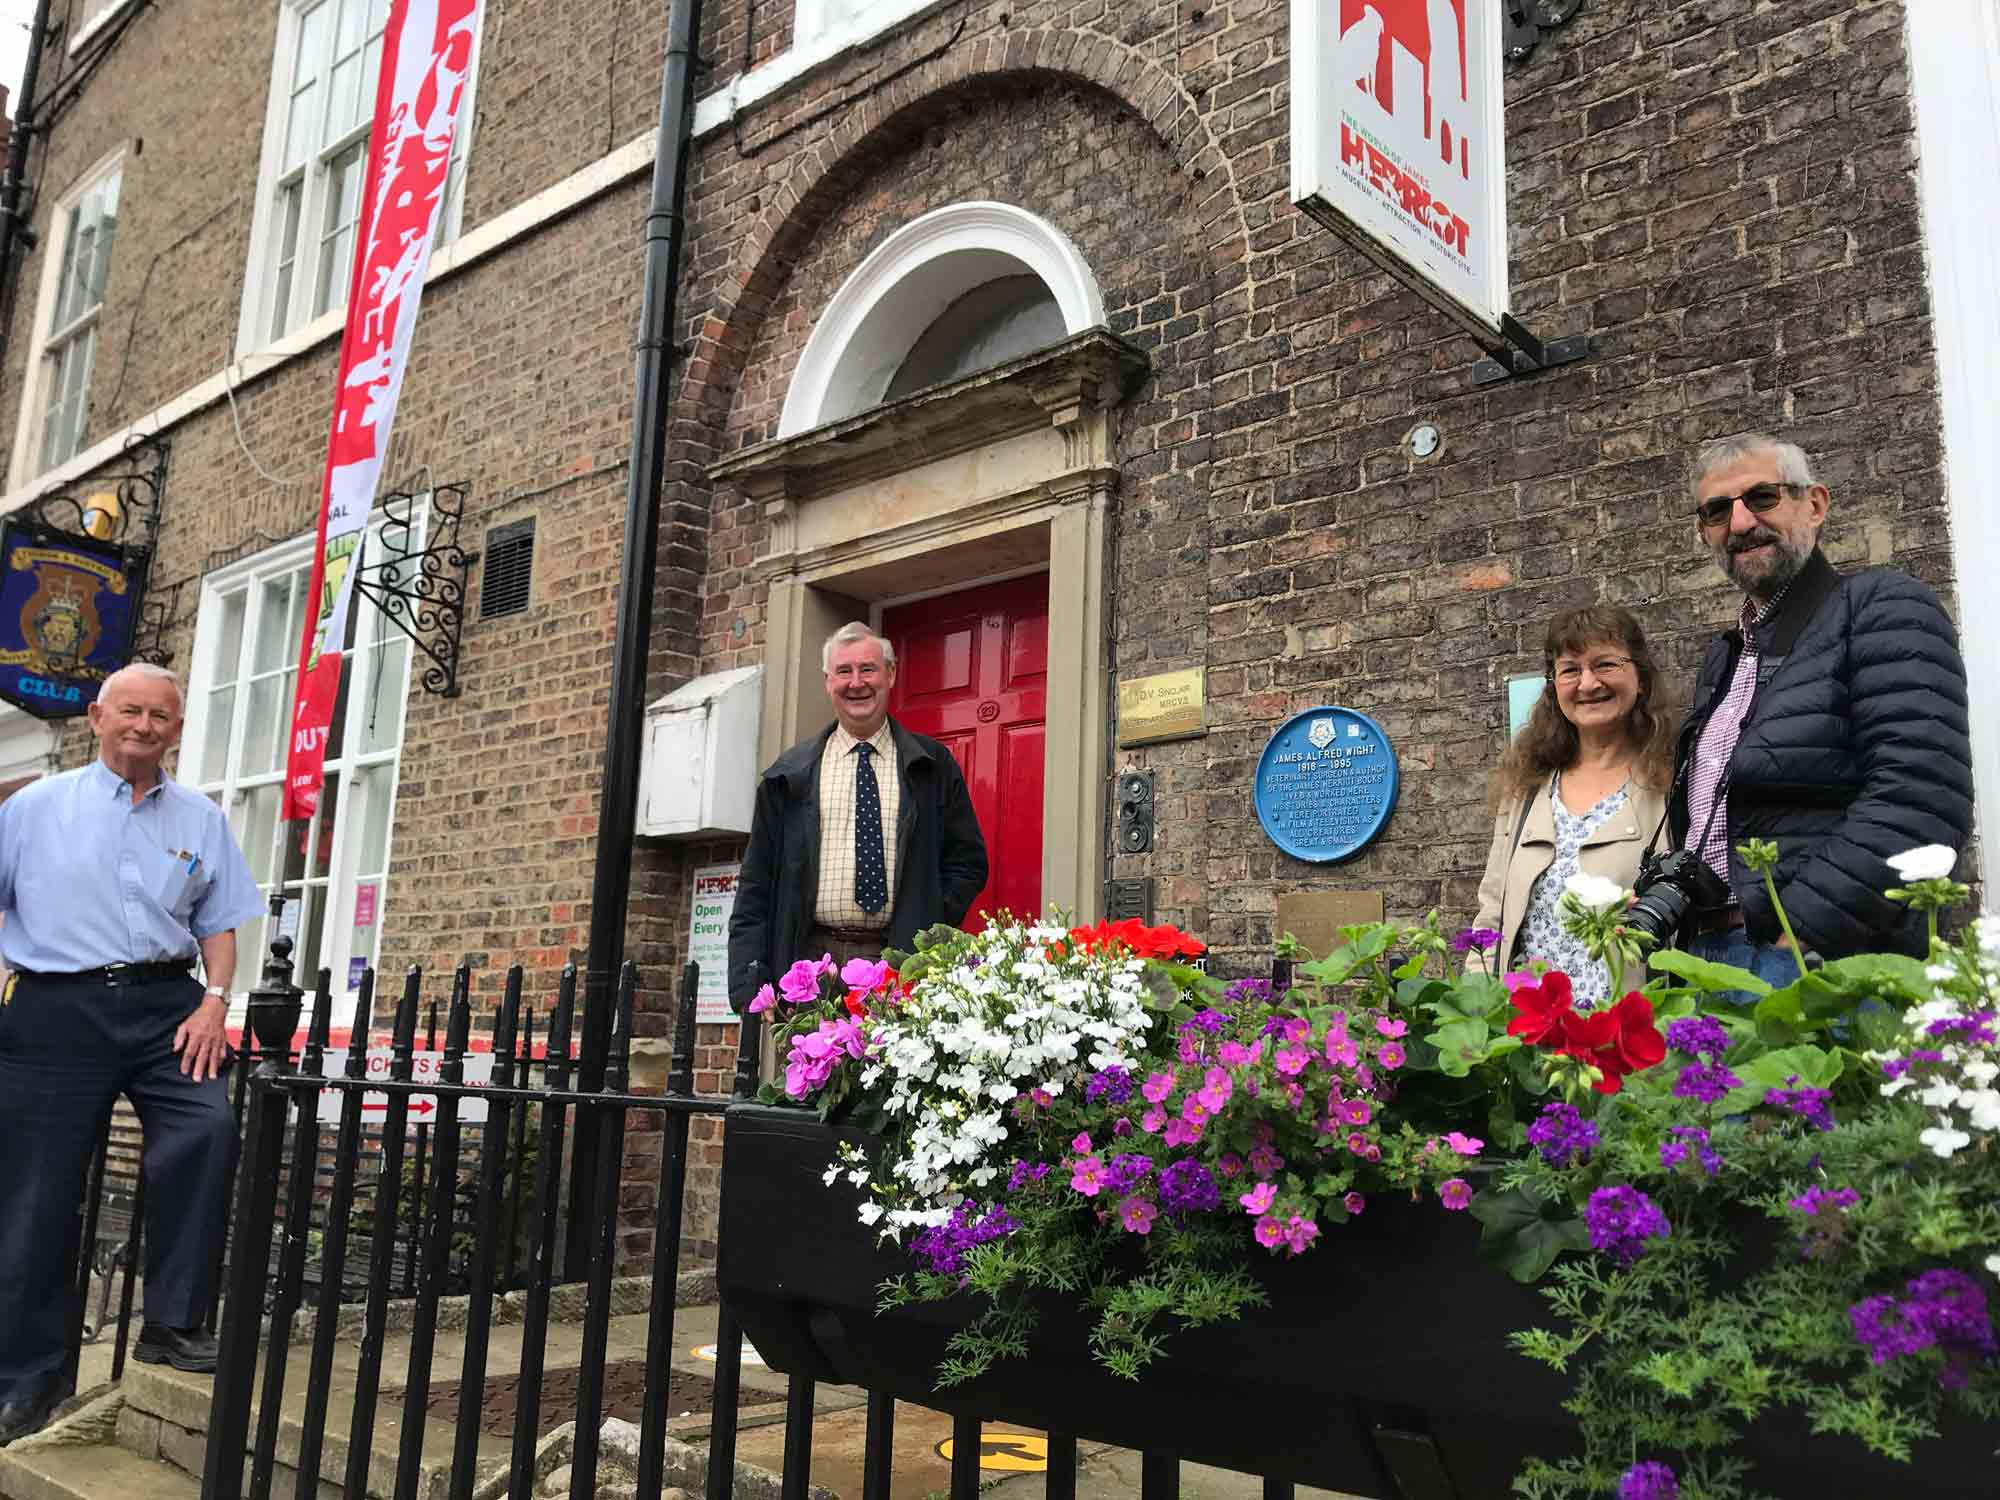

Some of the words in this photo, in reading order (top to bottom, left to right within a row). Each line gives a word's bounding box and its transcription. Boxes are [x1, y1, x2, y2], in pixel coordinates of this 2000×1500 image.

[1341, 108, 1358, 130] THE
[1360, 127, 1390, 156] WORLD
[1391, 151, 1403, 165] OF
[1403, 163, 1430, 189] JAMES
[1341, 121, 1470, 257] HERRIOT
[1341, 167, 1373, 197] MUSEUM
[1381, 200, 1422, 239] ATTRACTION
[1429, 238, 1458, 267] HISTORIC
[17, 676, 81, 701] CLUB
[1272, 752, 1303, 764] JAMES
[1306, 748, 1342, 761] ALFRED
[1345, 744, 1376, 757] WIGHT
[1297, 761, 1317, 773] 1916
[1330, 758, 1352, 770] 1995
[1313, 769, 1348, 781] SURGEON
[1355, 764, 1386, 776] AUTHOR
[1280, 783, 1294, 793] THE
[1295, 780, 1320, 791] JAMES
[1356, 774, 1383, 785] BOOKS
[1313, 788, 1346, 799] WORKED
[1349, 785, 1369, 796] HERE
[1315, 816, 1360, 827] TELEVISION
[696, 876, 738, 894] HERRI
[695, 904, 723, 917] Open
[694, 922, 724, 937] Every
